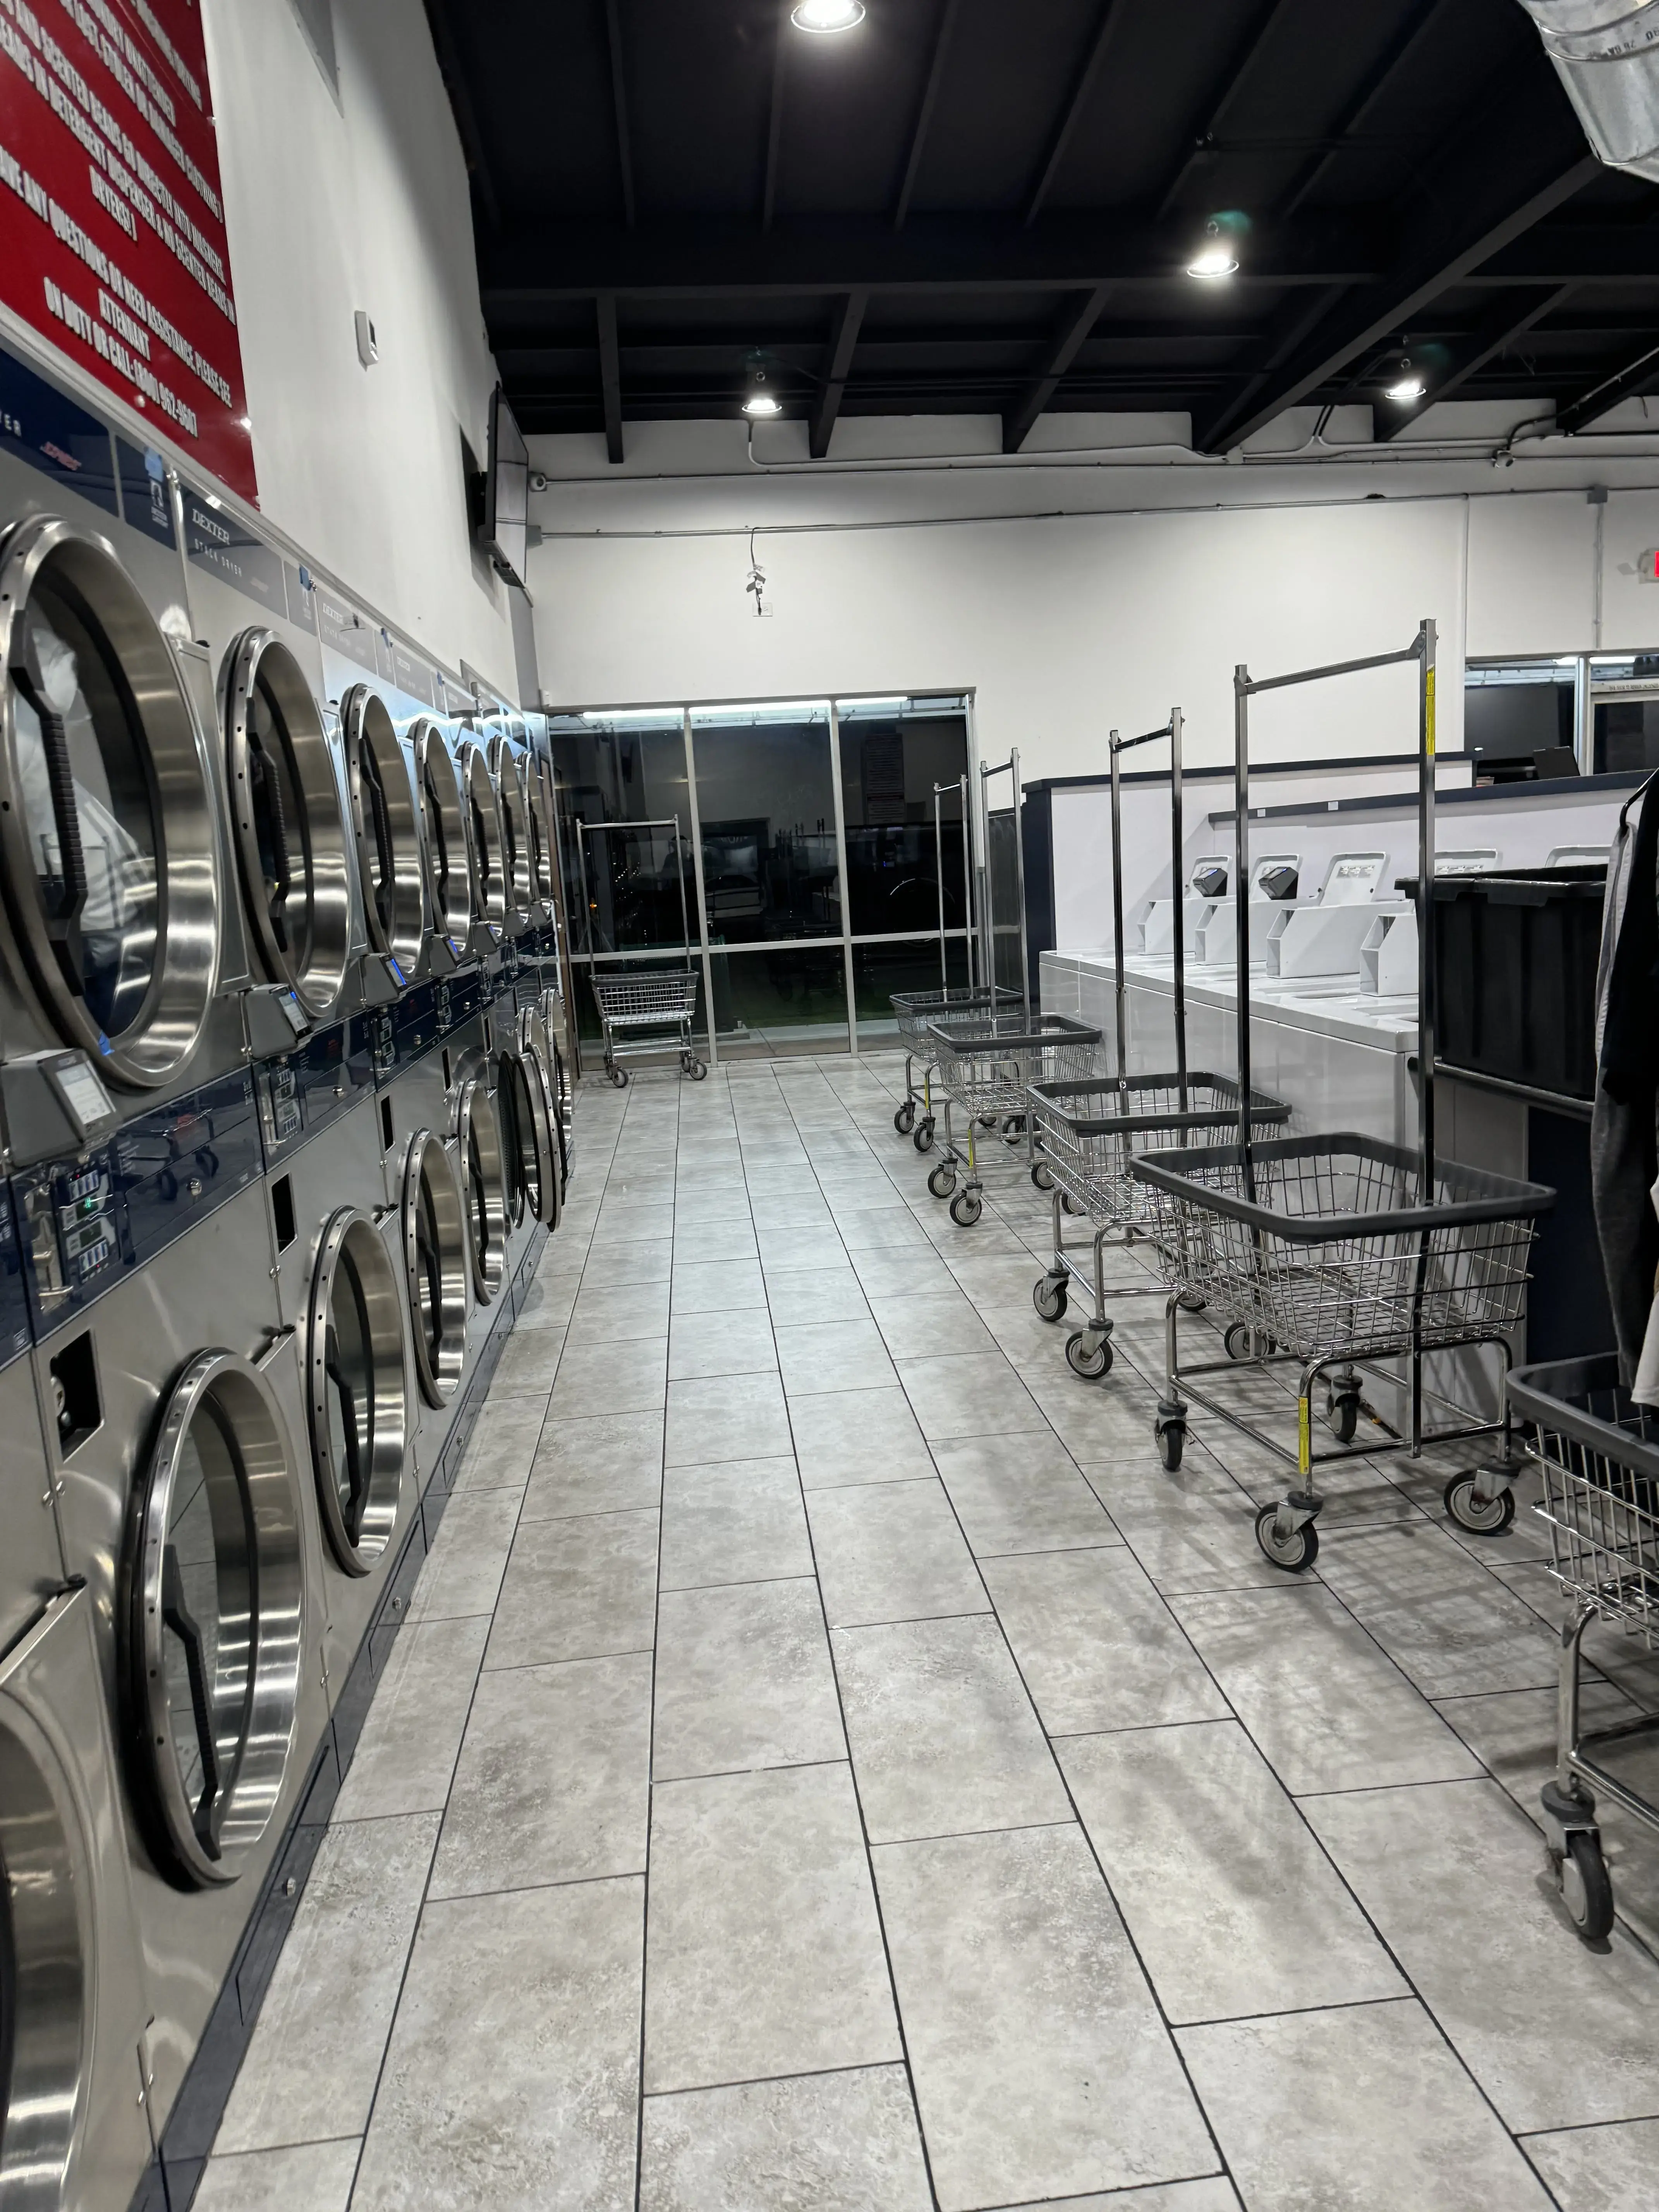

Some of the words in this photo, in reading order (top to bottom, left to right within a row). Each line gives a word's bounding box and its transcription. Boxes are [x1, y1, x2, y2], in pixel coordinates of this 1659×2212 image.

[48, 76, 106, 170] DETERGENT
[22, 171, 48, 222] ANY
[48, 198, 110, 284] QUESTIONS
[122, 276, 147, 322] NEED
[194, 351, 220, 396] PLEASE
[218, 376, 232, 408] SEE
[44, 276, 64, 319] ON
[62, 293, 93, 344] DUTY
[98, 289, 151, 361] ATTENDANT
[192, 508, 230, 545] DEXTER
[194, 538, 218, 562] STACK
[222, 556, 242, 577] DRYER
